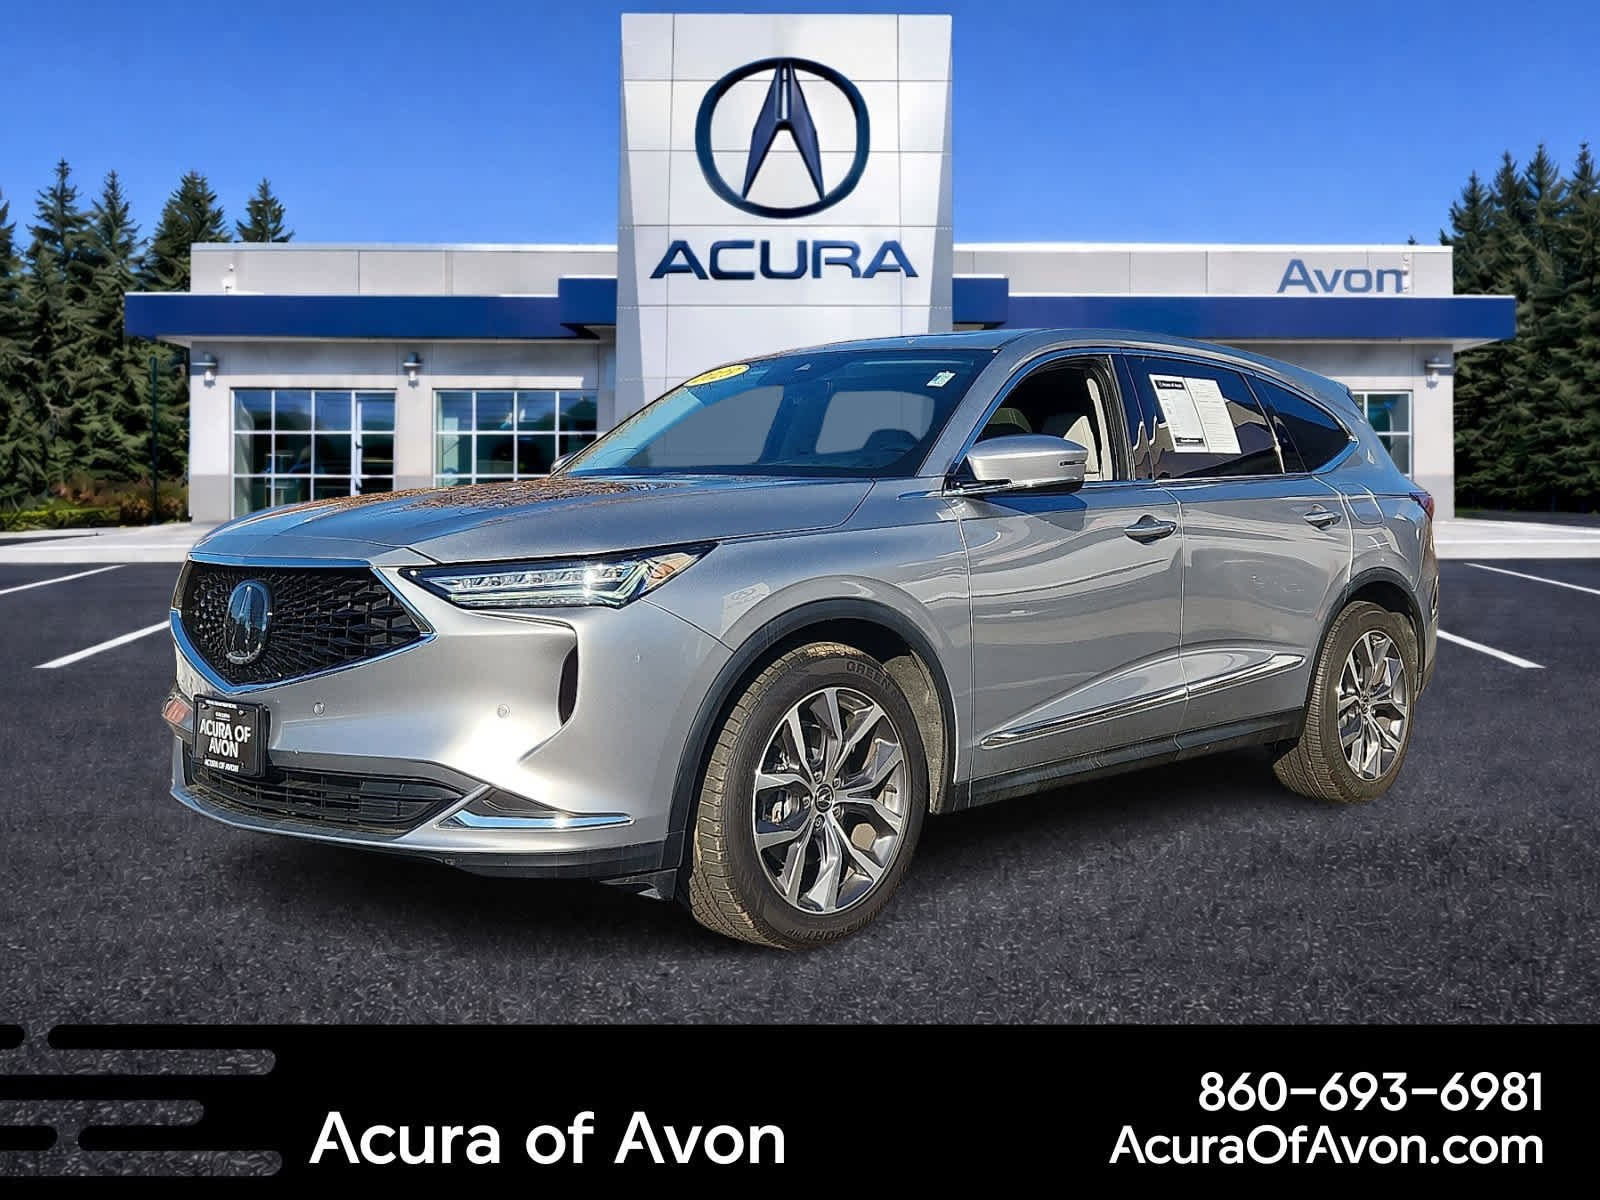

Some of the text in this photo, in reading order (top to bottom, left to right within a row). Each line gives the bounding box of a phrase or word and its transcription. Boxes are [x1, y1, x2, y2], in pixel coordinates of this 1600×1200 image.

[649, 240, 919, 280] ACURA
[1277, 258, 1403, 294] Avon
[846, 661, 890, 689] GREEN
[199, 718, 251, 743] ACURA OF
[208, 737, 239, 758] AVON
